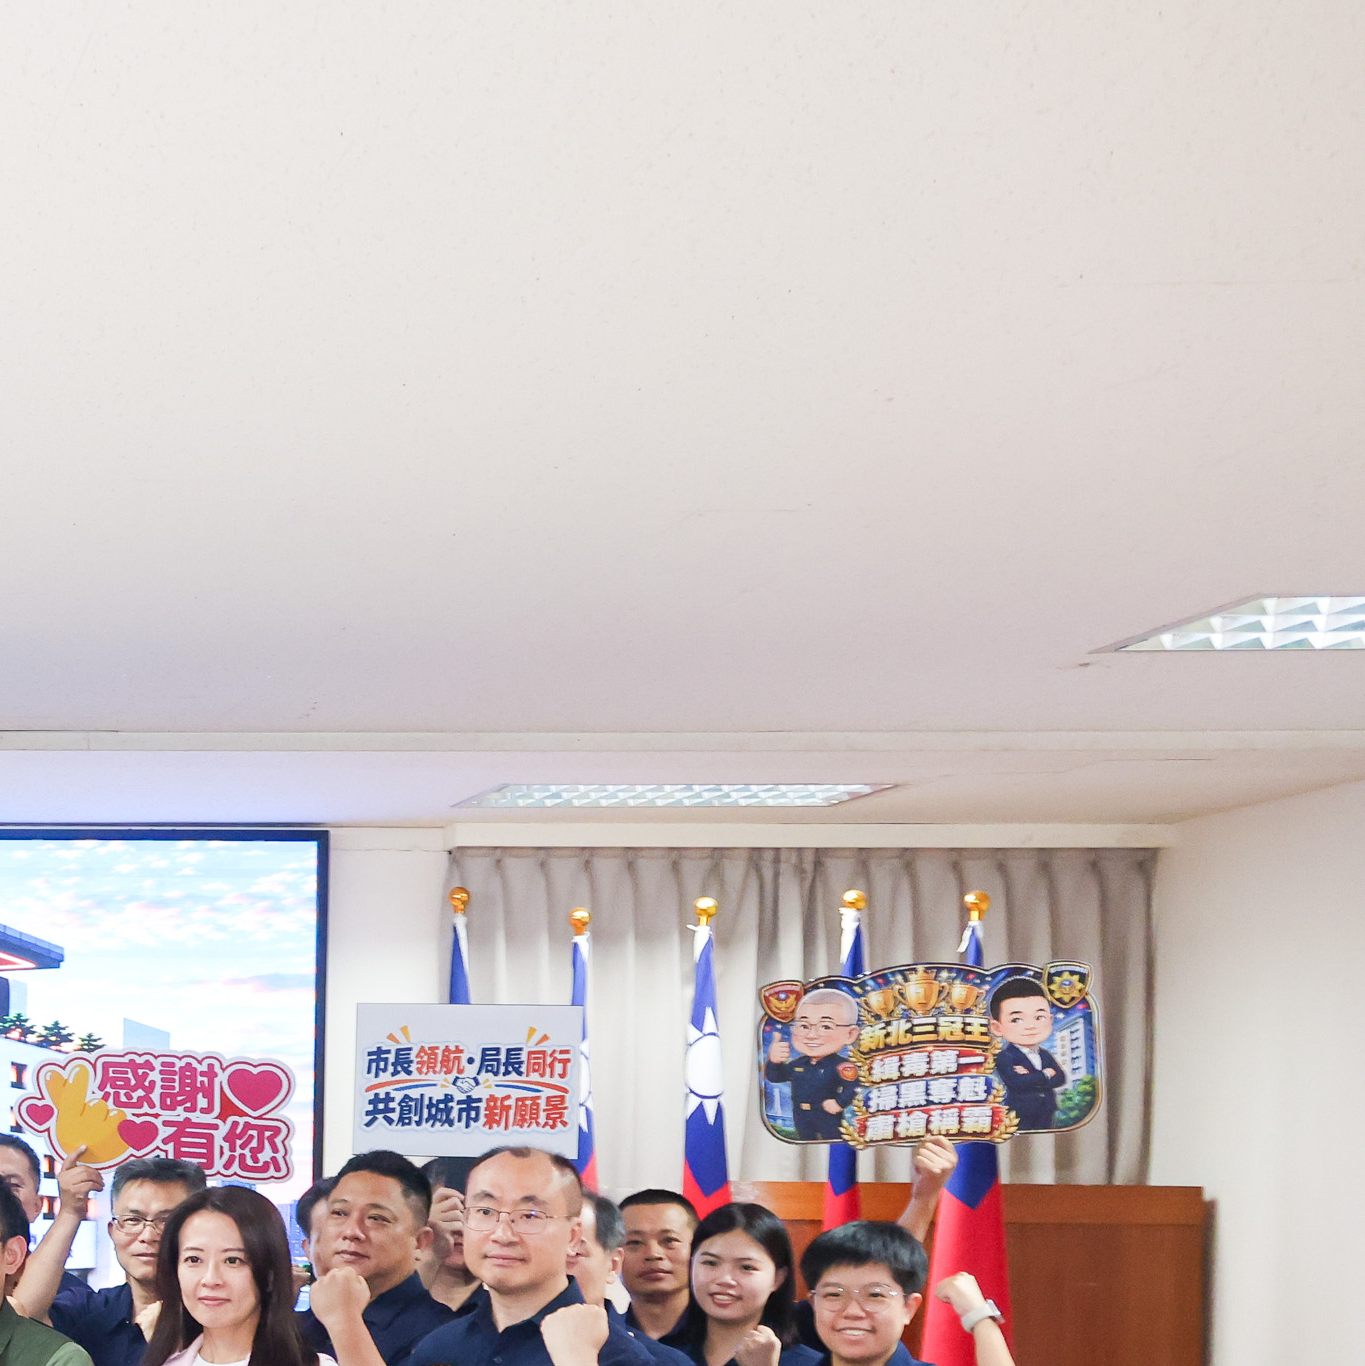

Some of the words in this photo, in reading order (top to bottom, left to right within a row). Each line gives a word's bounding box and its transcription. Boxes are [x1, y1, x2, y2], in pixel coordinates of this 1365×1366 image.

[859, 1016, 992, 1052] 新北三冠王
[870, 1050, 986, 1083] 緝毒第一
[98, 1058, 218, 1114] 感謝
[869, 1076, 988, 1113] 掃黑奪魁
[364, 1092, 569, 1130] 共創城市新願景
[162, 1117, 282, 1174] 有您
